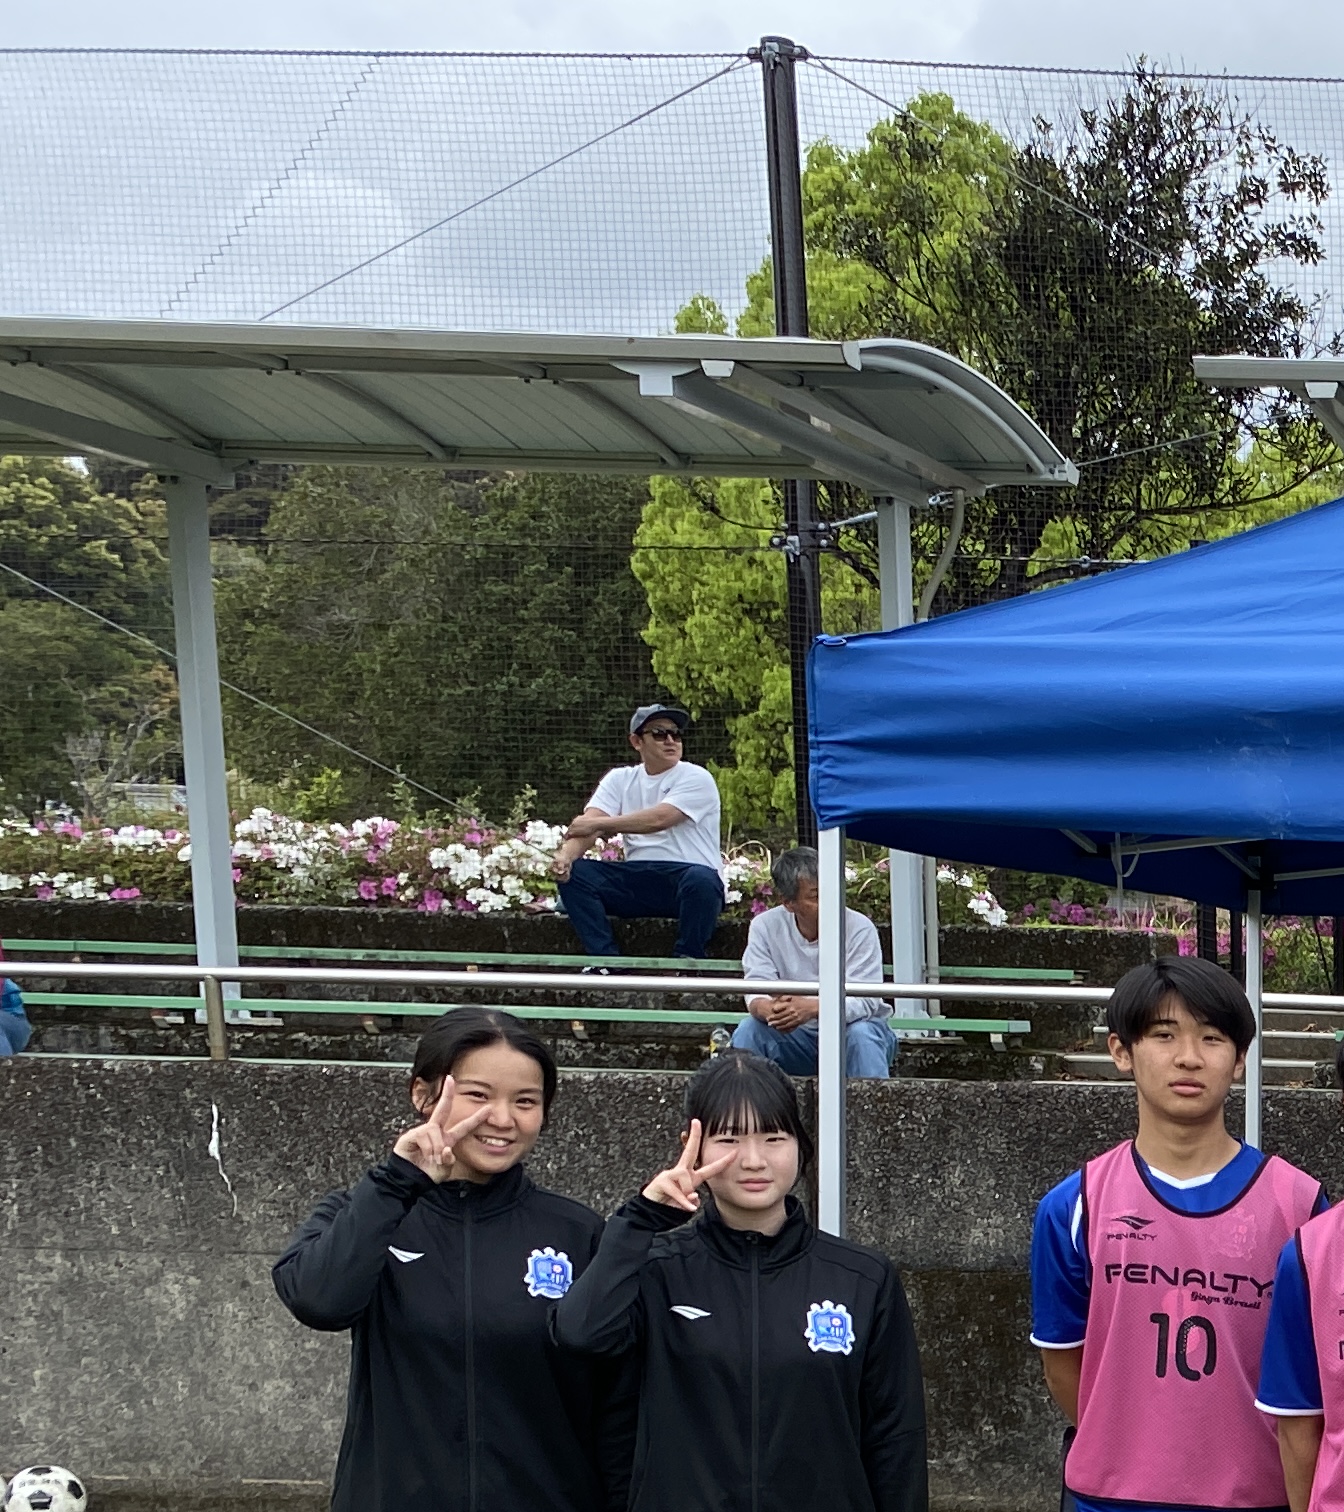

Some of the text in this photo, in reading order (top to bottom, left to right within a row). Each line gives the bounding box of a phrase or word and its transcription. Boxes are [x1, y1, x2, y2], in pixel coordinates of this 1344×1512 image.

[1107, 1232, 1158, 1241] PENALTY
[1104, 1262, 1275, 1298] PENALTY
[1149, 1312, 1218, 1382] 10
